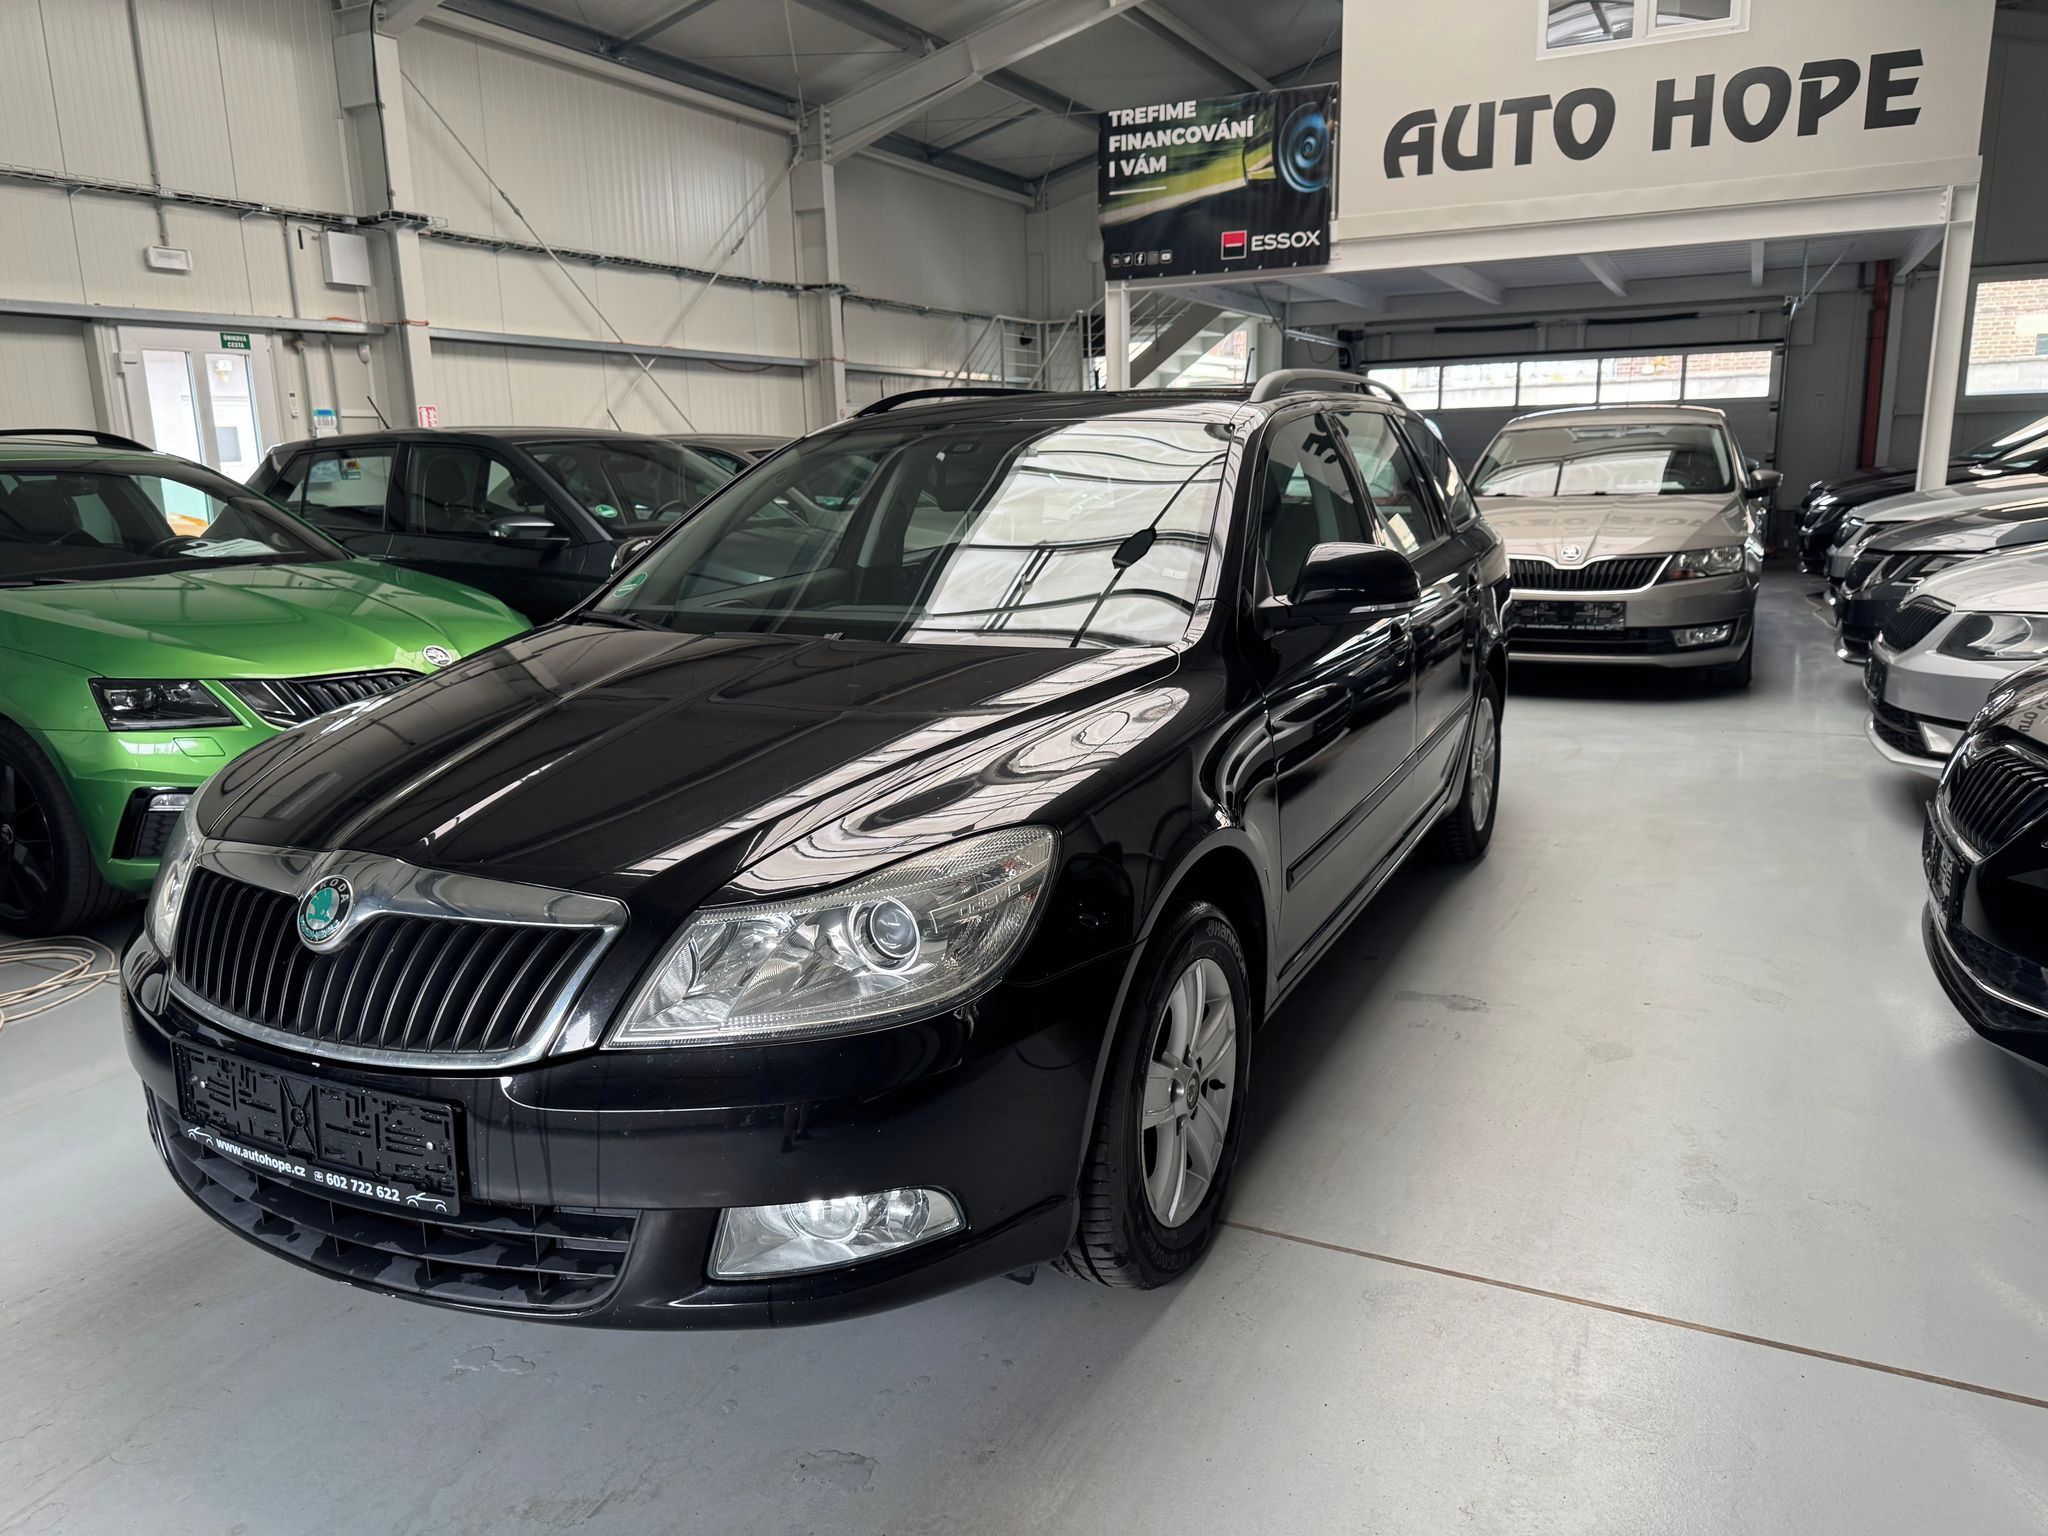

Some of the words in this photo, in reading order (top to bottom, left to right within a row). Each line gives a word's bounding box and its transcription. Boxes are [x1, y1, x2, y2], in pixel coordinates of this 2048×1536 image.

[1108, 100, 1197, 127] TREFIME
[1383, 87, 1616, 179] AUTO
[1651, 48, 1924, 152] HOPE
[1108, 115, 1256, 152] FINANCOVÁNÍ
[1108, 160, 1116, 178] I
[1120, 154, 1167, 177] VÁM
[1251, 229, 1321, 252] ESSOX
[215, 1138, 306, 1177] www.autohope.cz
[326, 1173, 348, 1190] 602
[350, 1179, 373, 1196] 722
[376, 1186, 400, 1202] 622
